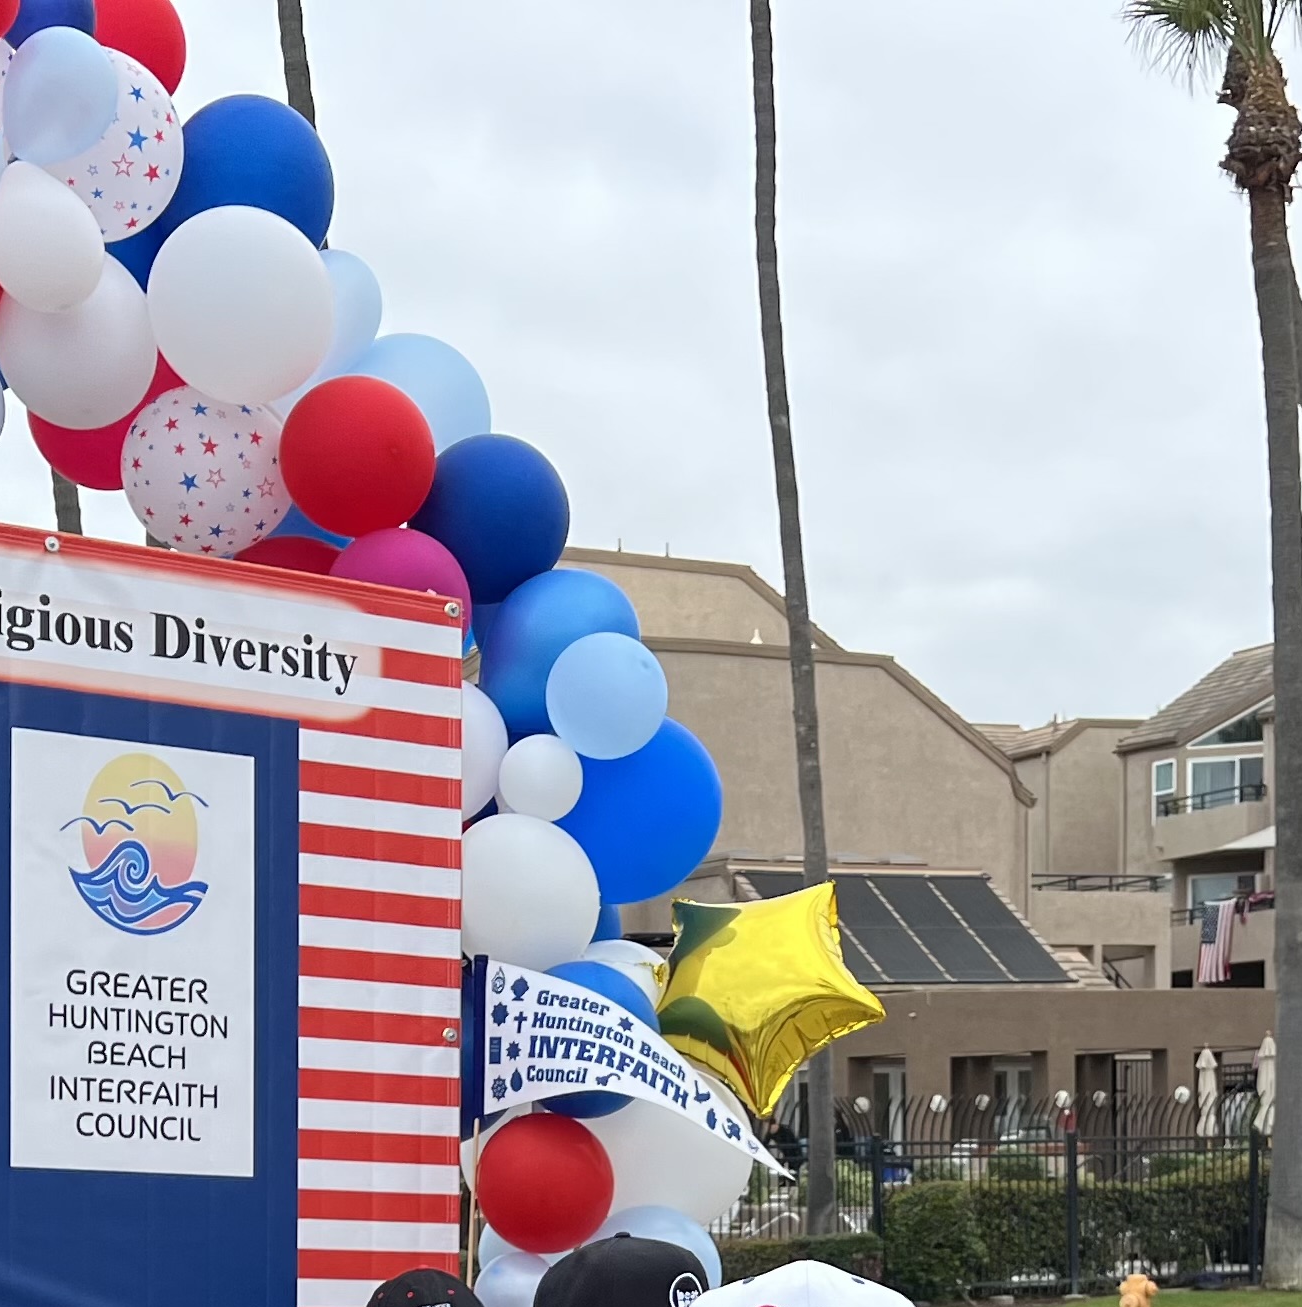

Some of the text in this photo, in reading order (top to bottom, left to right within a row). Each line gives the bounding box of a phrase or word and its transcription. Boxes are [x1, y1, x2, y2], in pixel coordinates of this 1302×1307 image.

[149, 611, 359, 695] Diversity
[66, 969, 208, 1004] GREATER
[536, 990, 610, 1016] Greater
[49, 1003, 228, 1038] HUNTINGTON
[88, 1041, 186, 1069] BEACH
[531, 1012, 686, 1081] Huntington Beach
[527, 1065, 588, 1083] Council
[528, 1035, 689, 1110] INTERFAITH
[50, 1075, 218, 1108] INTERFAITH
[76, 1112, 201, 1141] COUNCIL
